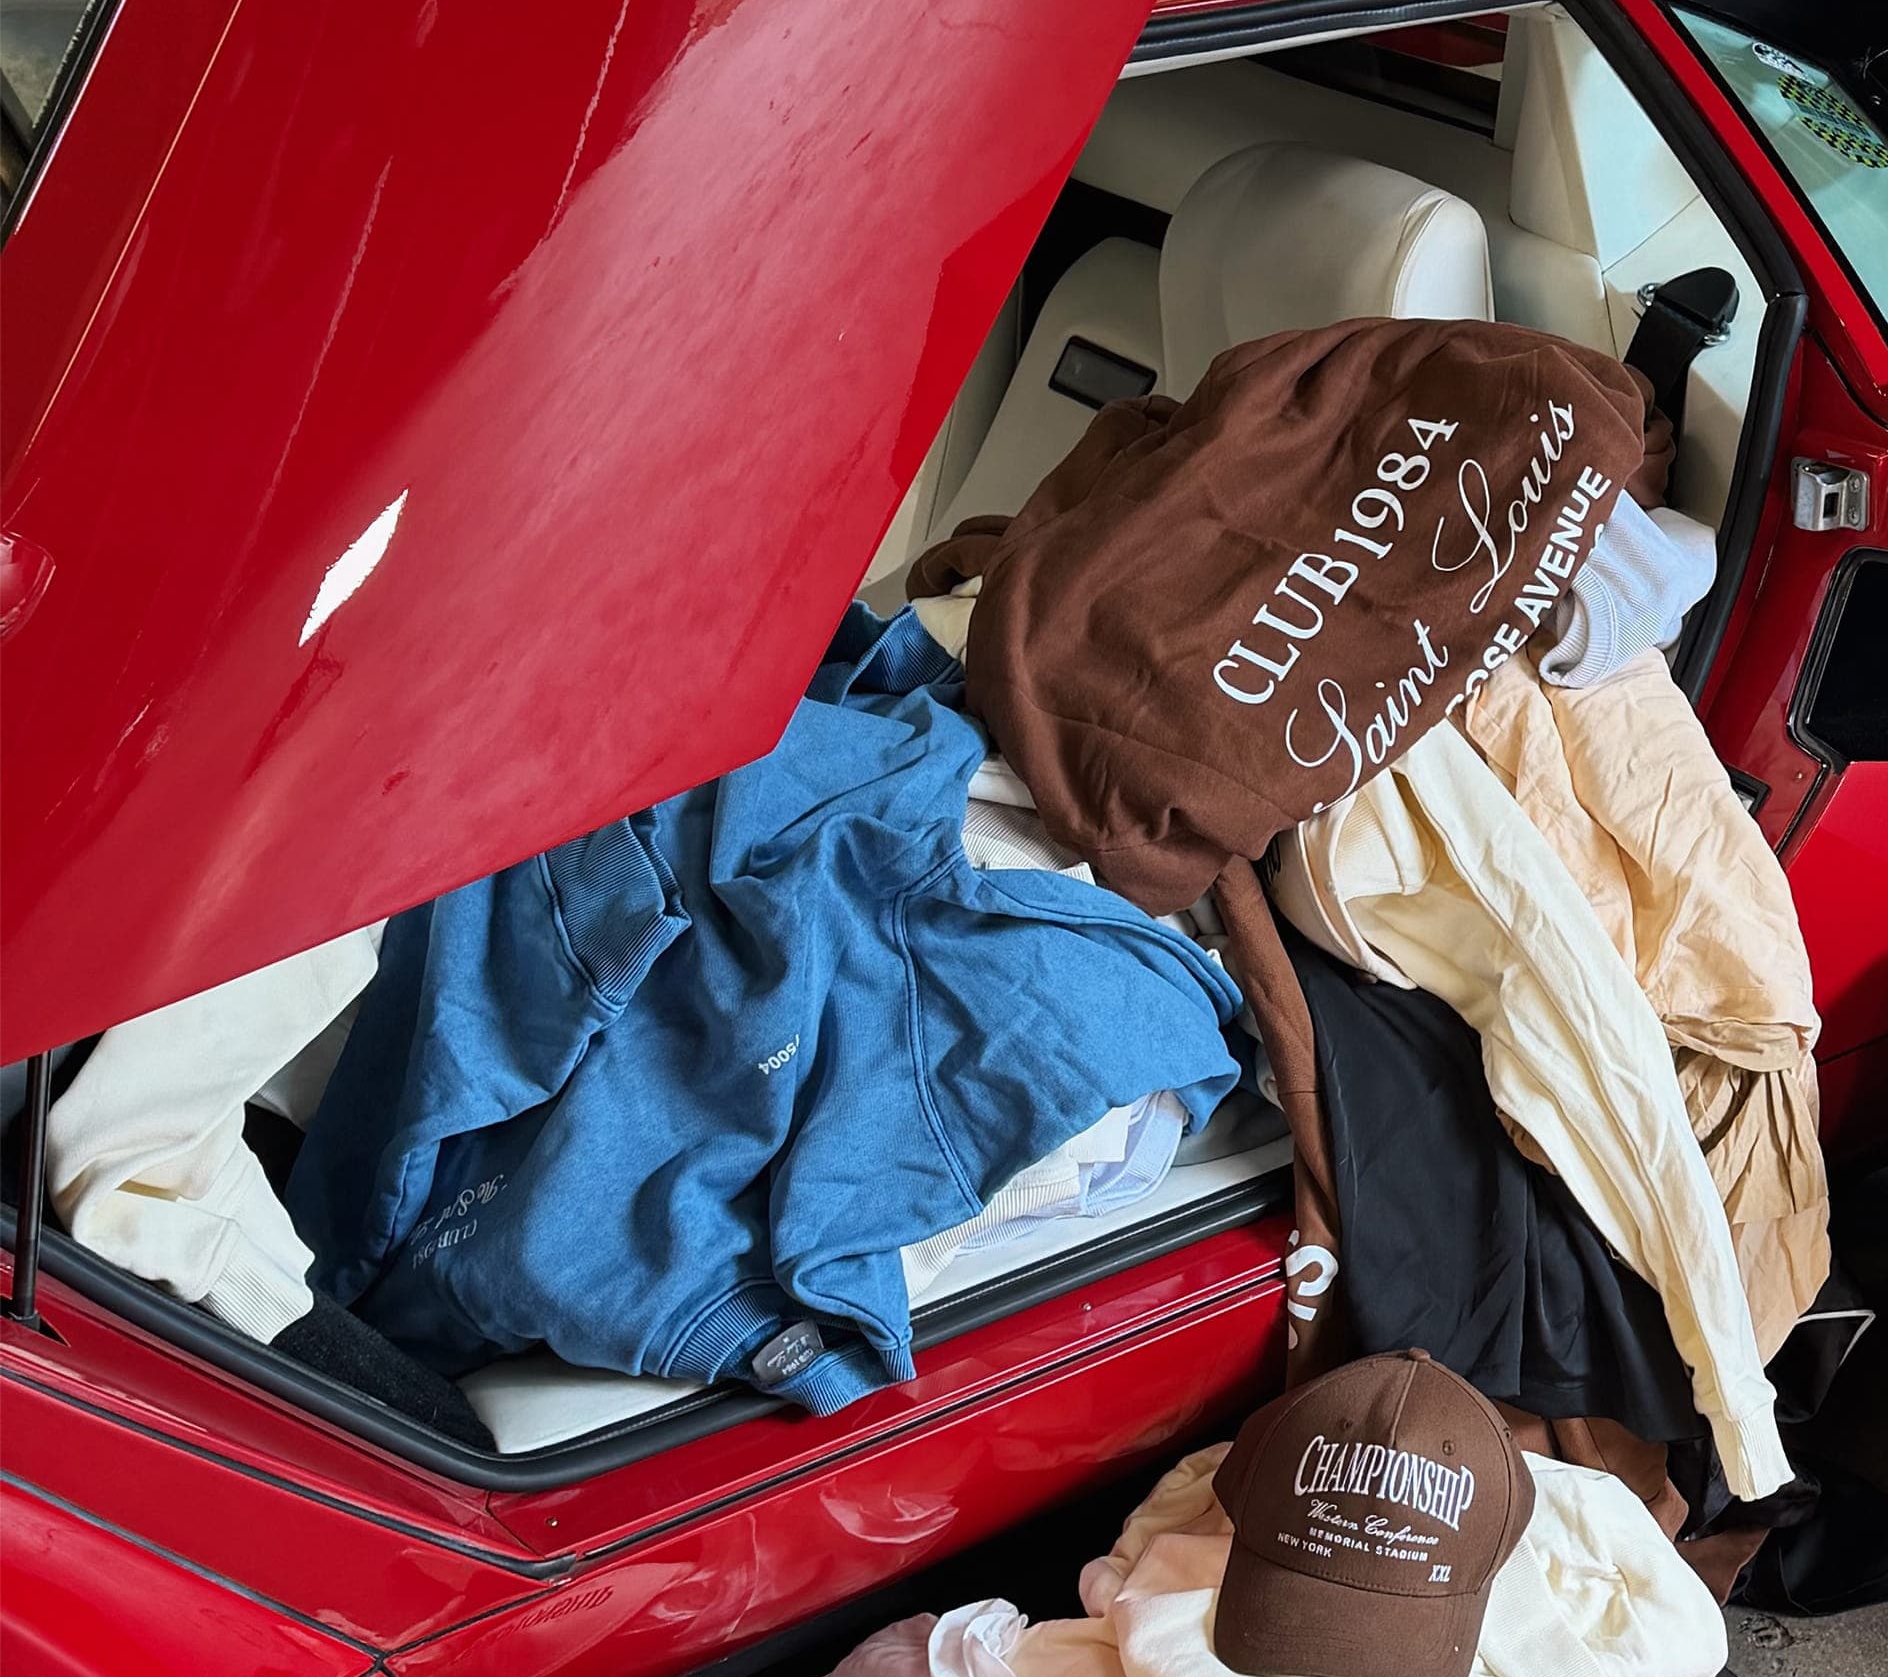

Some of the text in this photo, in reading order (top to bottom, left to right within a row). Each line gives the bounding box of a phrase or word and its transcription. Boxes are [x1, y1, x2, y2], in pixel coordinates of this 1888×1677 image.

[1513, 465, 1612, 629] AVENUE
[1285, 399, 1574, 813] Saint Louis
[1293, 1434, 1476, 1531] CHAMPIONSHIP
[1277, 1531, 1333, 1559] NEW YORK
[1306, 1498, 1440, 1547] Western Conference
[1309, 1526, 1428, 1563] MEMORIAL STADIUM
[1428, 1564, 1451, 1583] XXL
